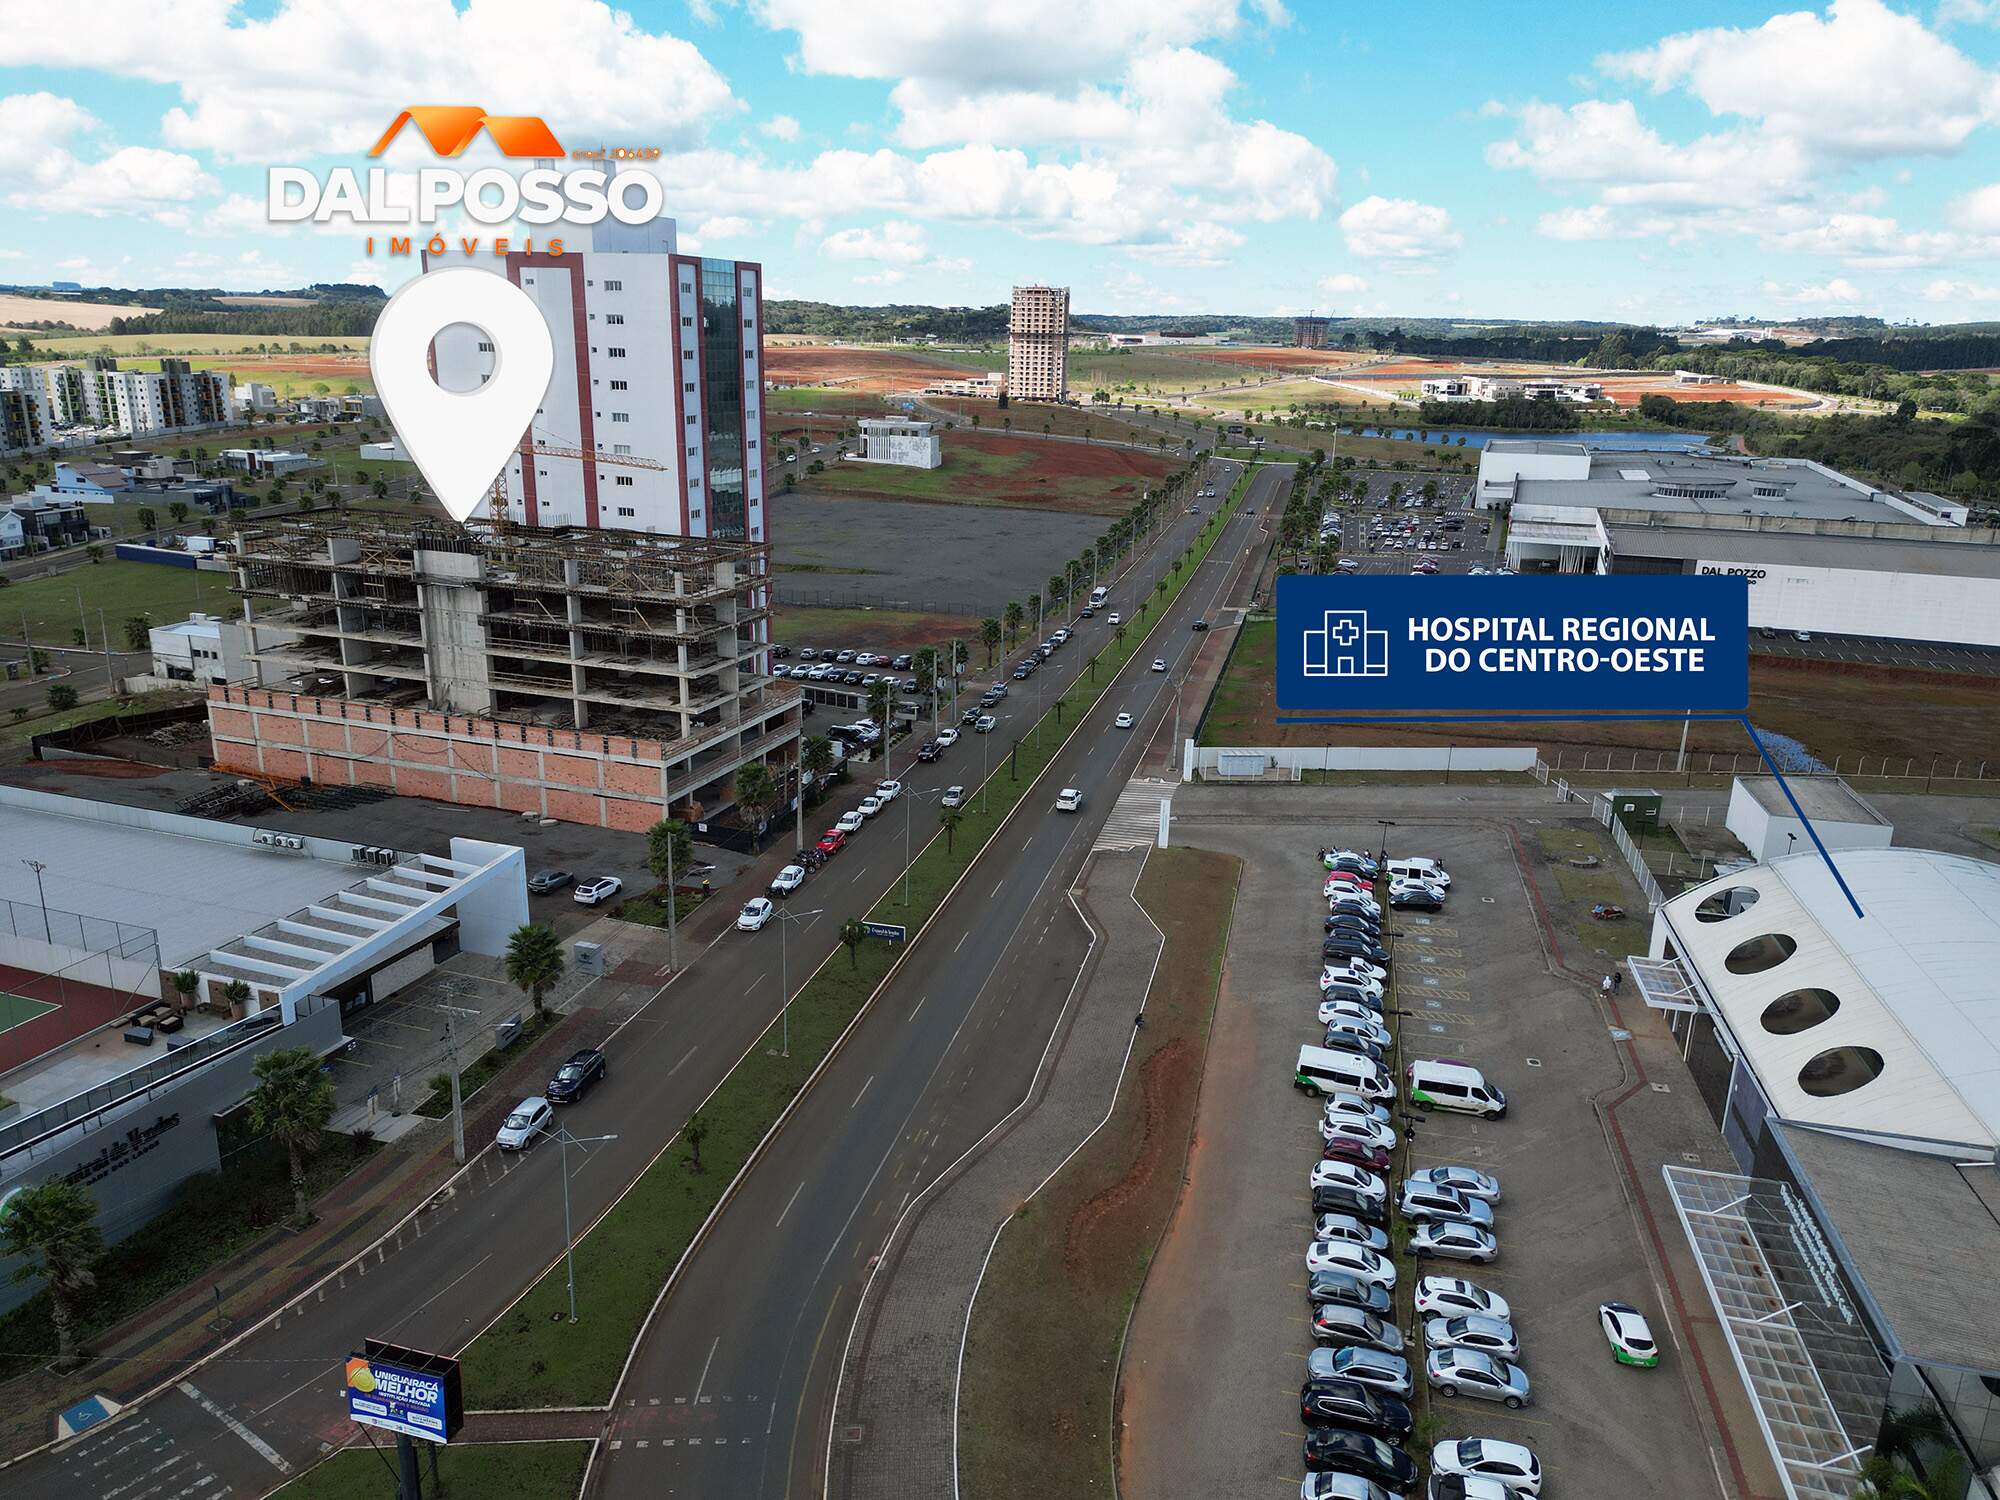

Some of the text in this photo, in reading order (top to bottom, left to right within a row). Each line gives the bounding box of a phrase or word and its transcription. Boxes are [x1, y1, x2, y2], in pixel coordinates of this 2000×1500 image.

[1701, 566, 1767, 579] DAL POZZO
[374, 1369, 439, 1391] UNIGUAIRACÁ
[374, 1379, 438, 1404] MELHOR
